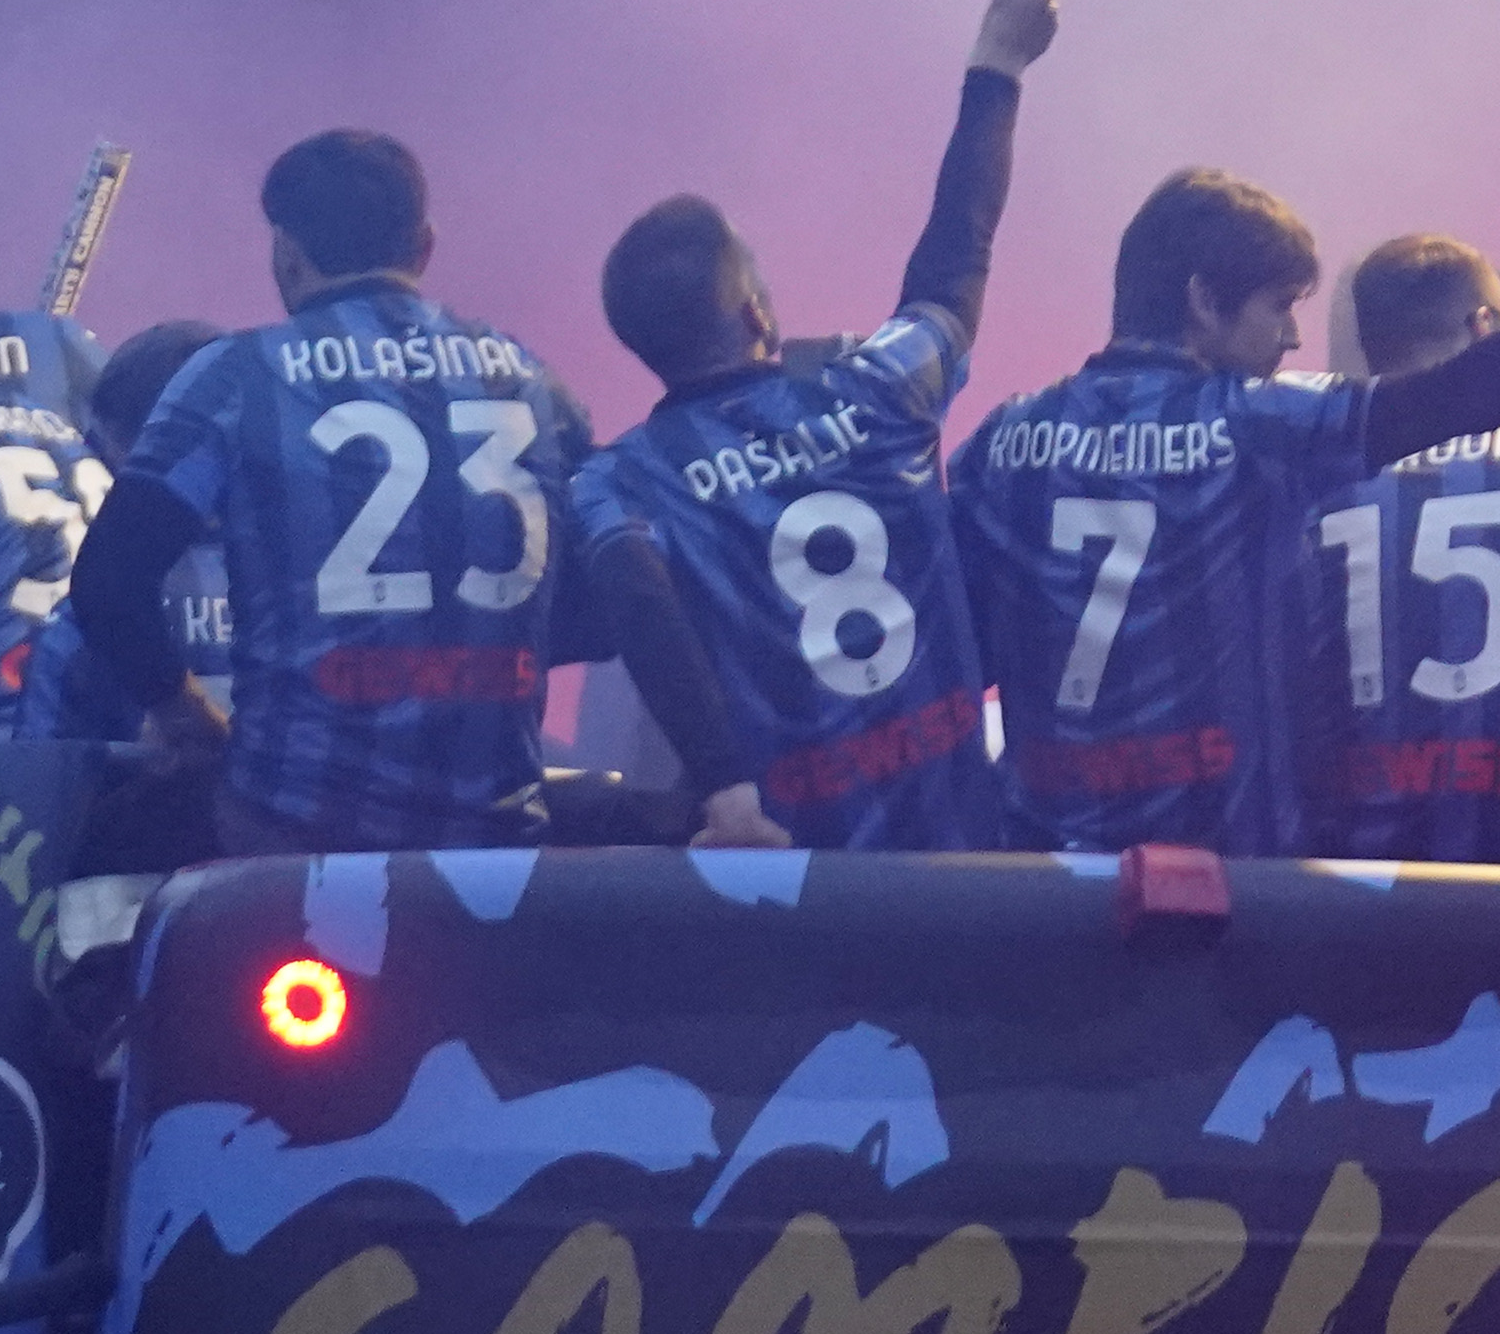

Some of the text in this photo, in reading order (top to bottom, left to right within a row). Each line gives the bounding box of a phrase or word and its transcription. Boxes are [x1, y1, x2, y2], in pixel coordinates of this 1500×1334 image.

[309, 399, 550, 616] 23
[769, 490, 916, 697] 8
[1050, 496, 1157, 712] 7
